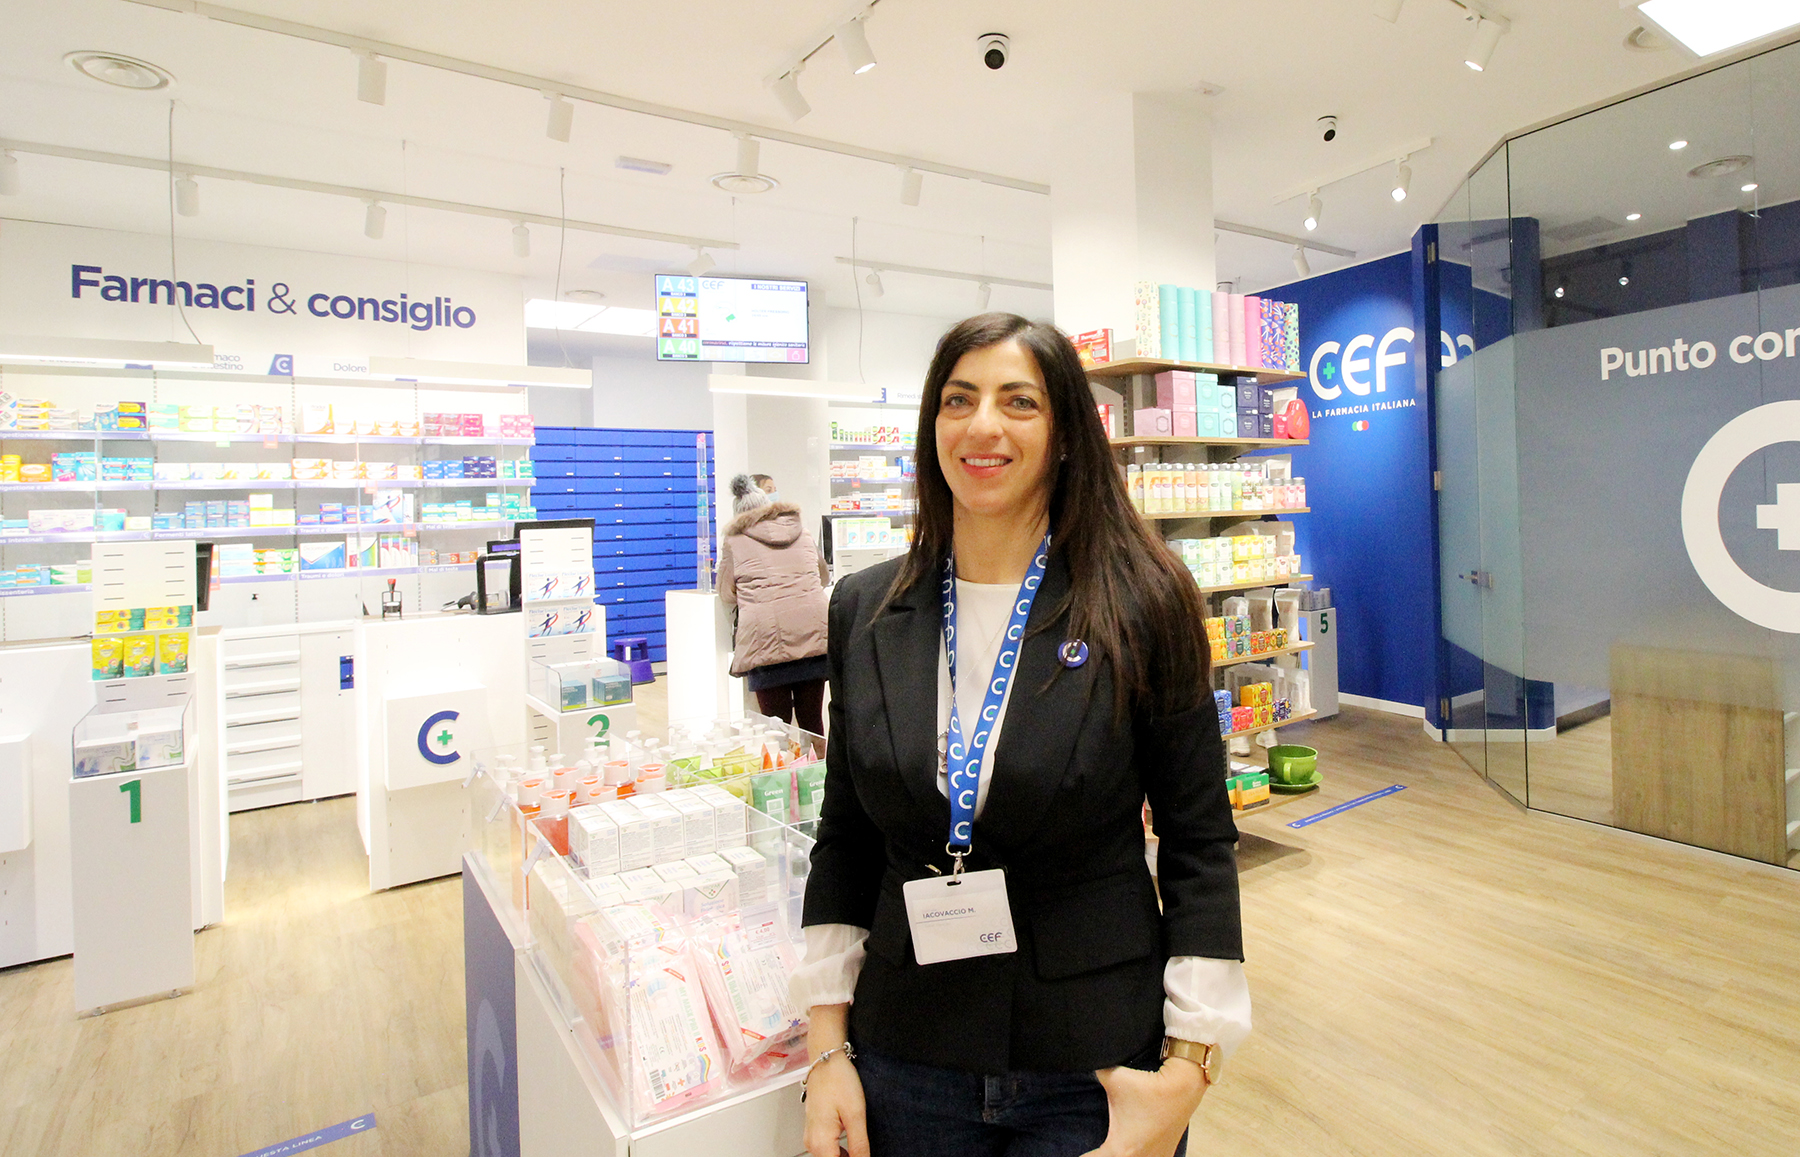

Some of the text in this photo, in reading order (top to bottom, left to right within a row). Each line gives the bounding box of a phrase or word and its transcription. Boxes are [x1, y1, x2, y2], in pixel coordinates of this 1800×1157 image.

[662, 278, 695, 292] A 43
[702, 280, 725, 290] CEF
[71, 264, 477, 332] Farmaci & consiglio
[662, 298, 695, 313] A 42
[663, 318, 695, 333] A 41
[663, 339, 675, 353] A
[678, 340, 696, 354] 40
[1309, 326, 1415, 401] CEF
[1600, 337, 1717, 381] Punto
[333, 362, 367, 374] Dolore
[1312, 398, 1416, 419] LA FARMACIA ITALIANA
[1319, 613, 1329, 634] 5
[586, 714, 610, 747] 2
[764, 788, 784, 797] Green
[119, 779, 141, 823] 1
[922, 908, 966, 919] IACOVACCIO
[979, 932, 1002, 943] CEF
[678, 986, 688, 998] MY
[682, 998, 694, 1017] MASK
[689, 1017, 698, 1031] PRO
[695, 1036, 707, 1053] KIDS
[292, 1135, 322, 1148] LINEA
